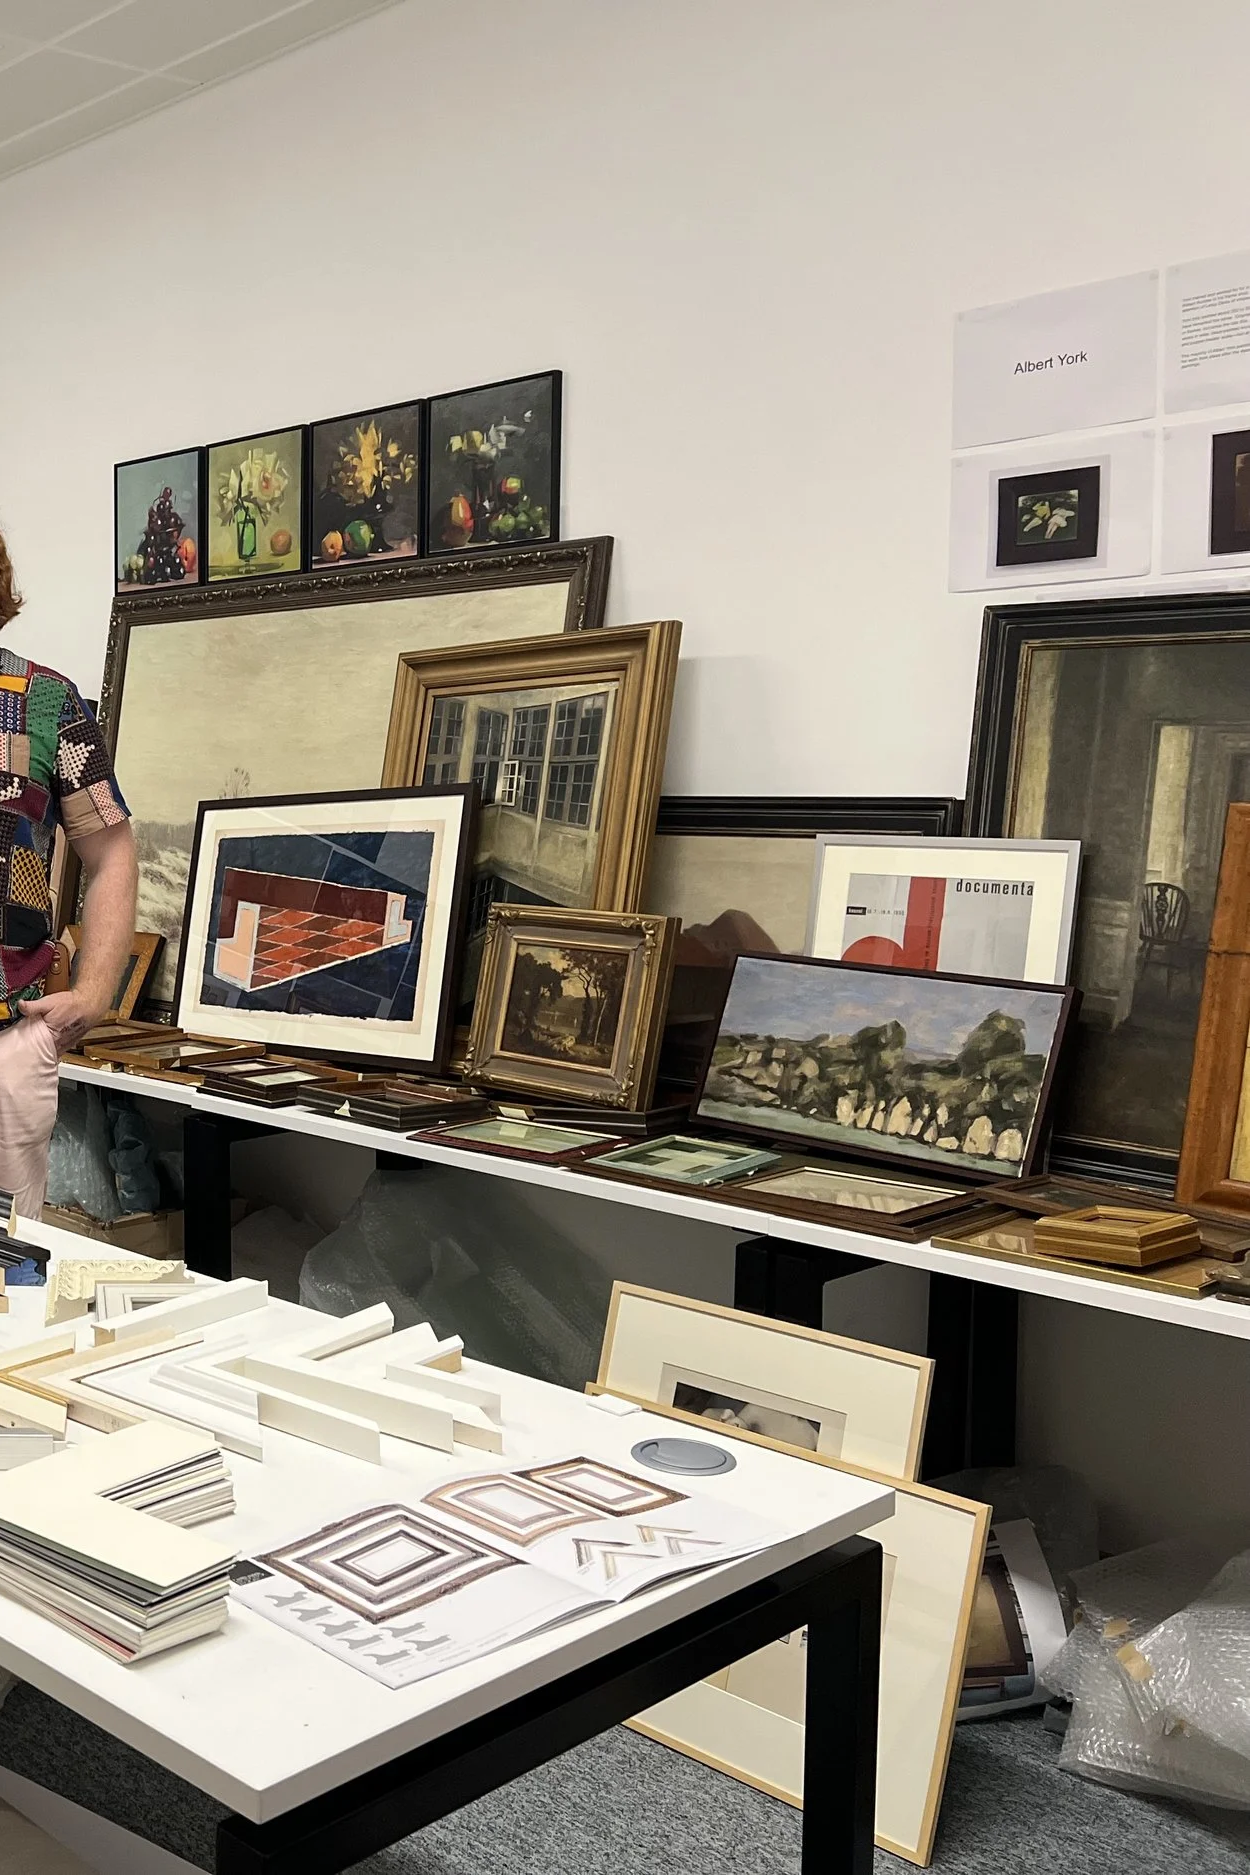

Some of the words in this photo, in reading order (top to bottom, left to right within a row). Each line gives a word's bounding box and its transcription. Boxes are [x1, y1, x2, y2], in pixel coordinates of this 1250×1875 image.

[1015, 357, 1053, 374] Albert
[1058, 351, 1087, 366] York
[956, 879, 1033, 895] documenta
